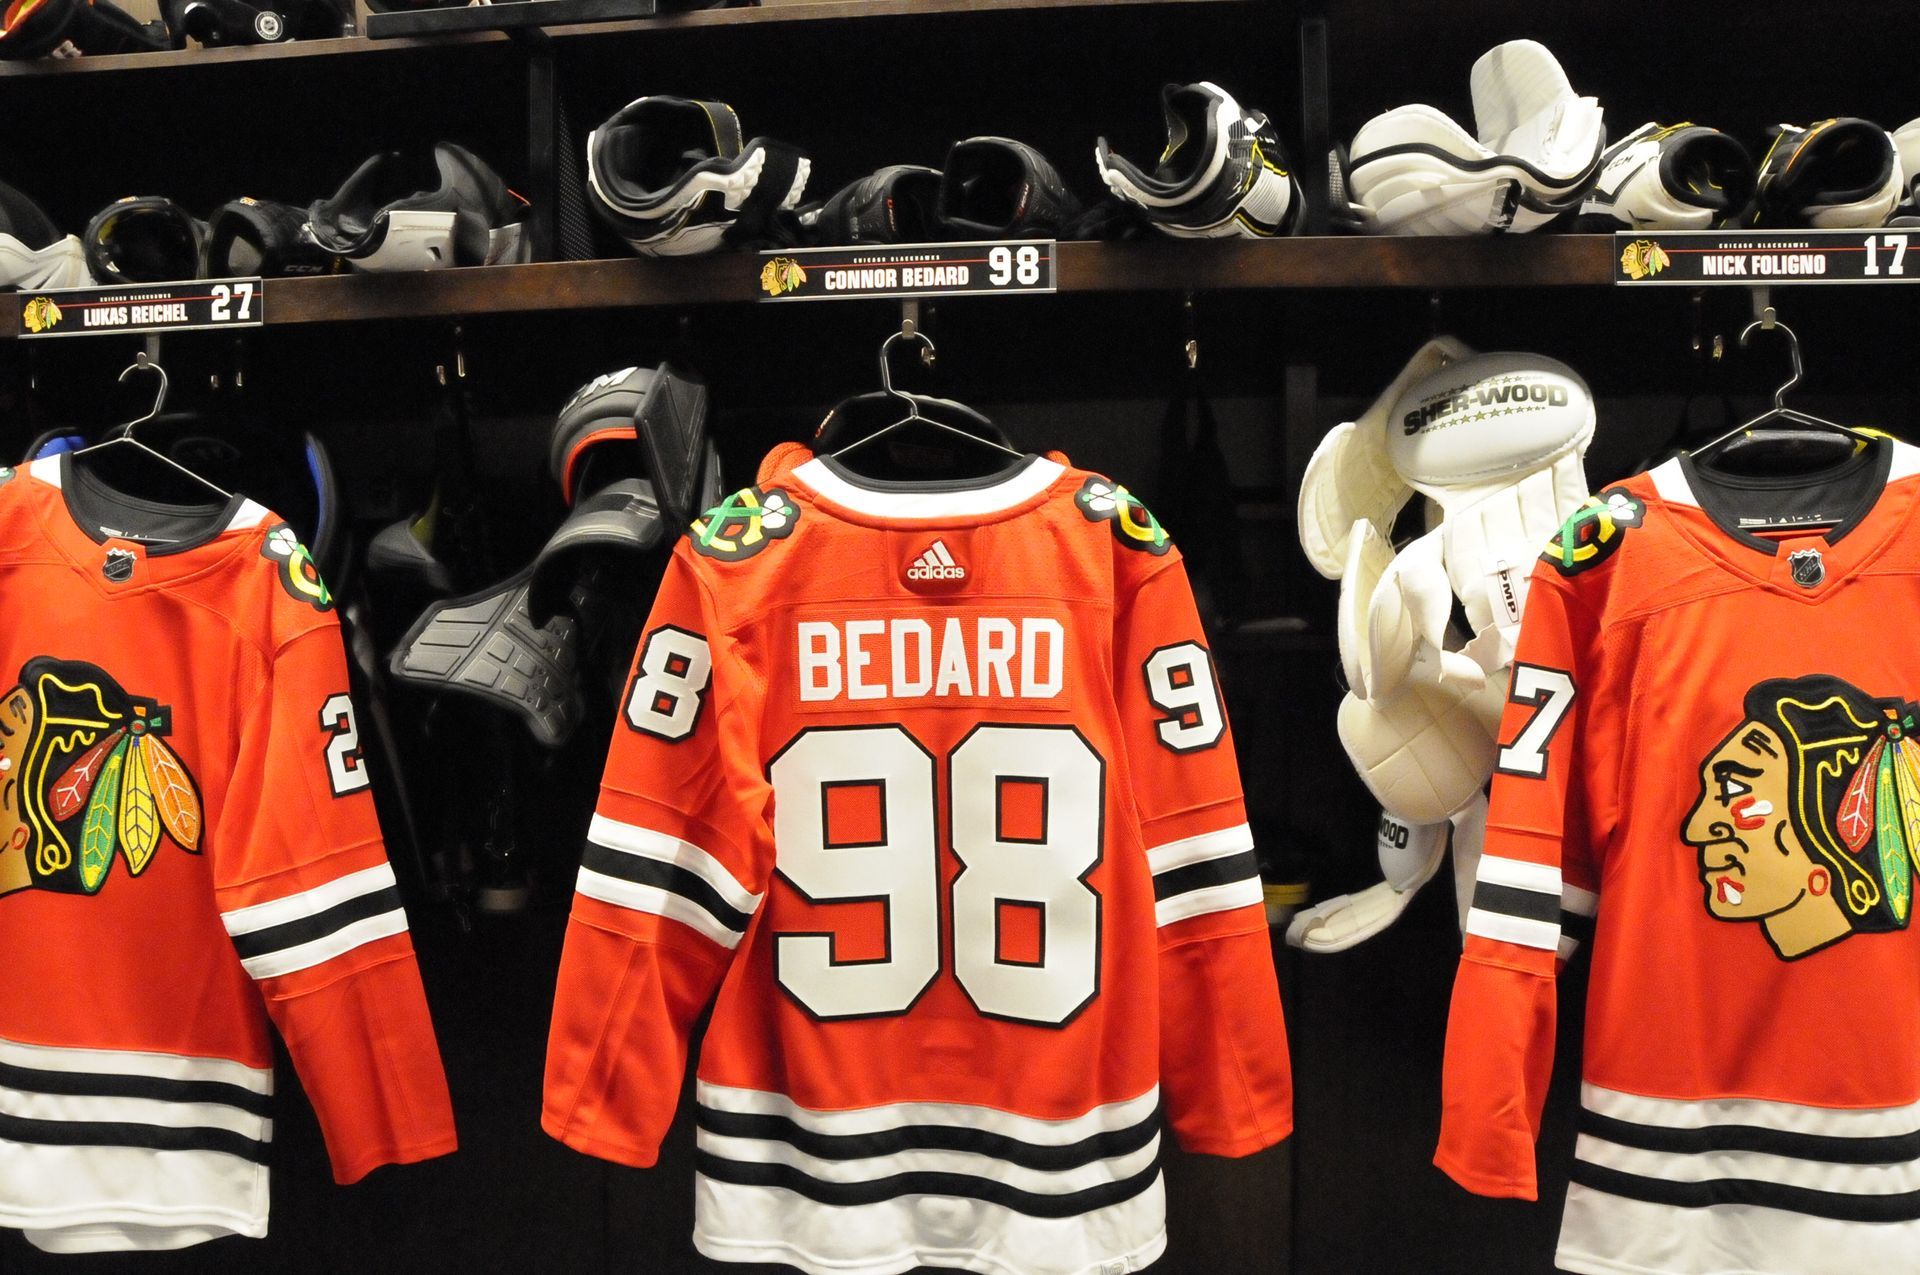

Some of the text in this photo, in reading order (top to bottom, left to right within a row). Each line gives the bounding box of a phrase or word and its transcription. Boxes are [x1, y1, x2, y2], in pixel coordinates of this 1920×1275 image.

[988, 246, 1040, 286] 98
[1702, 254, 1826, 276] NICK FOLIGNO
[1863, 235, 1908, 276] 17
[824, 266, 970, 290] CONNOR BEDARD
[83, 303, 189, 326] LUKAS REICHEL
[210, 283, 254, 321] 27
[1403, 383, 1569, 436] SHER-WOOD
[906, 564, 965, 580] adidas
[1500, 569, 1516, 613] PMP
[798, 617, 1065, 702] BEDARD
[622, 623, 713, 743] 8
[1141, 639, 1227, 755] 9
[1497, 661, 1578, 781] 7
[318, 692, 371, 800] 2
[765, 721, 1106, 1030] 98
